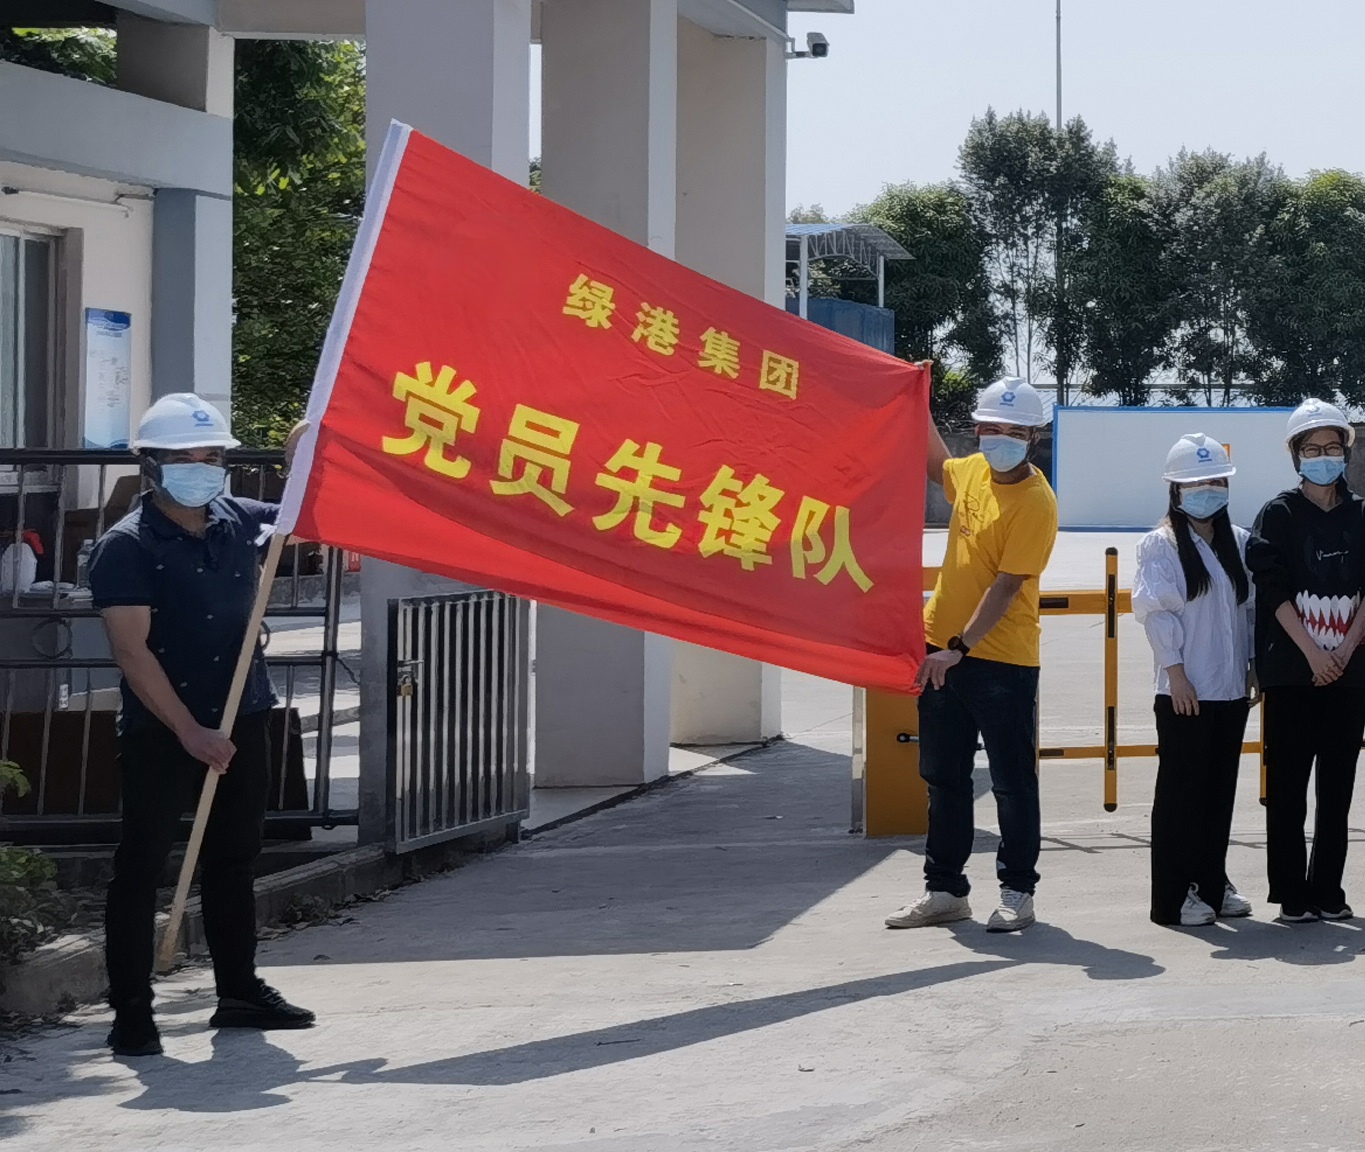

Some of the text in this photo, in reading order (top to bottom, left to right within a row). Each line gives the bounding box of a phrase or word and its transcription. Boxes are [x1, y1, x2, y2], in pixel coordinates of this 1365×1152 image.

[562, 273, 799, 400] 绿港集团
[381, 360, 875, 594] 党员先锋队
